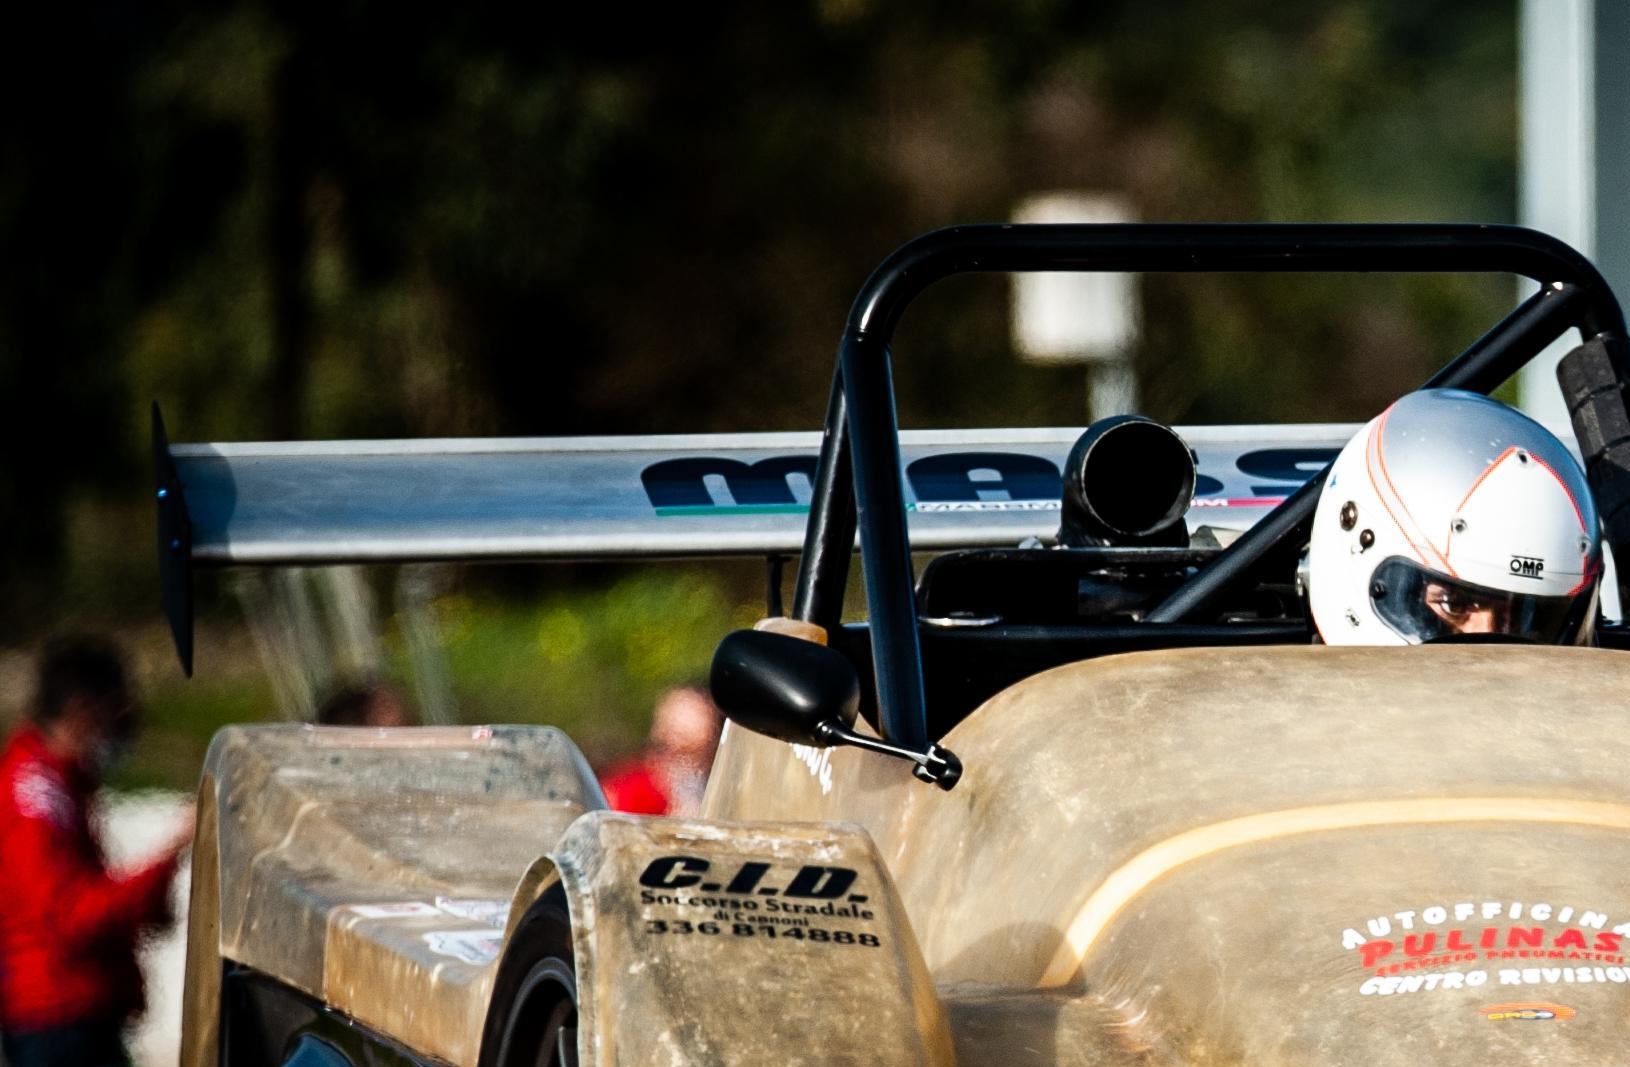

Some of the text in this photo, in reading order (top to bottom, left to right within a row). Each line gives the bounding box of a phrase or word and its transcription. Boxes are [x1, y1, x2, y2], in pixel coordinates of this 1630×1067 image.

[1510, 558, 1545, 577] OMP
[639, 856, 869, 903] C.I.D.
[640, 889, 874, 921] Soccorso Stradale
[713, 910, 809, 927] di Cannoni
[646, 919, 881, 948] 336 814888
[1358, 926, 1624, 969] PULINAS
[1358, 969, 1488, 996] CENTRO
